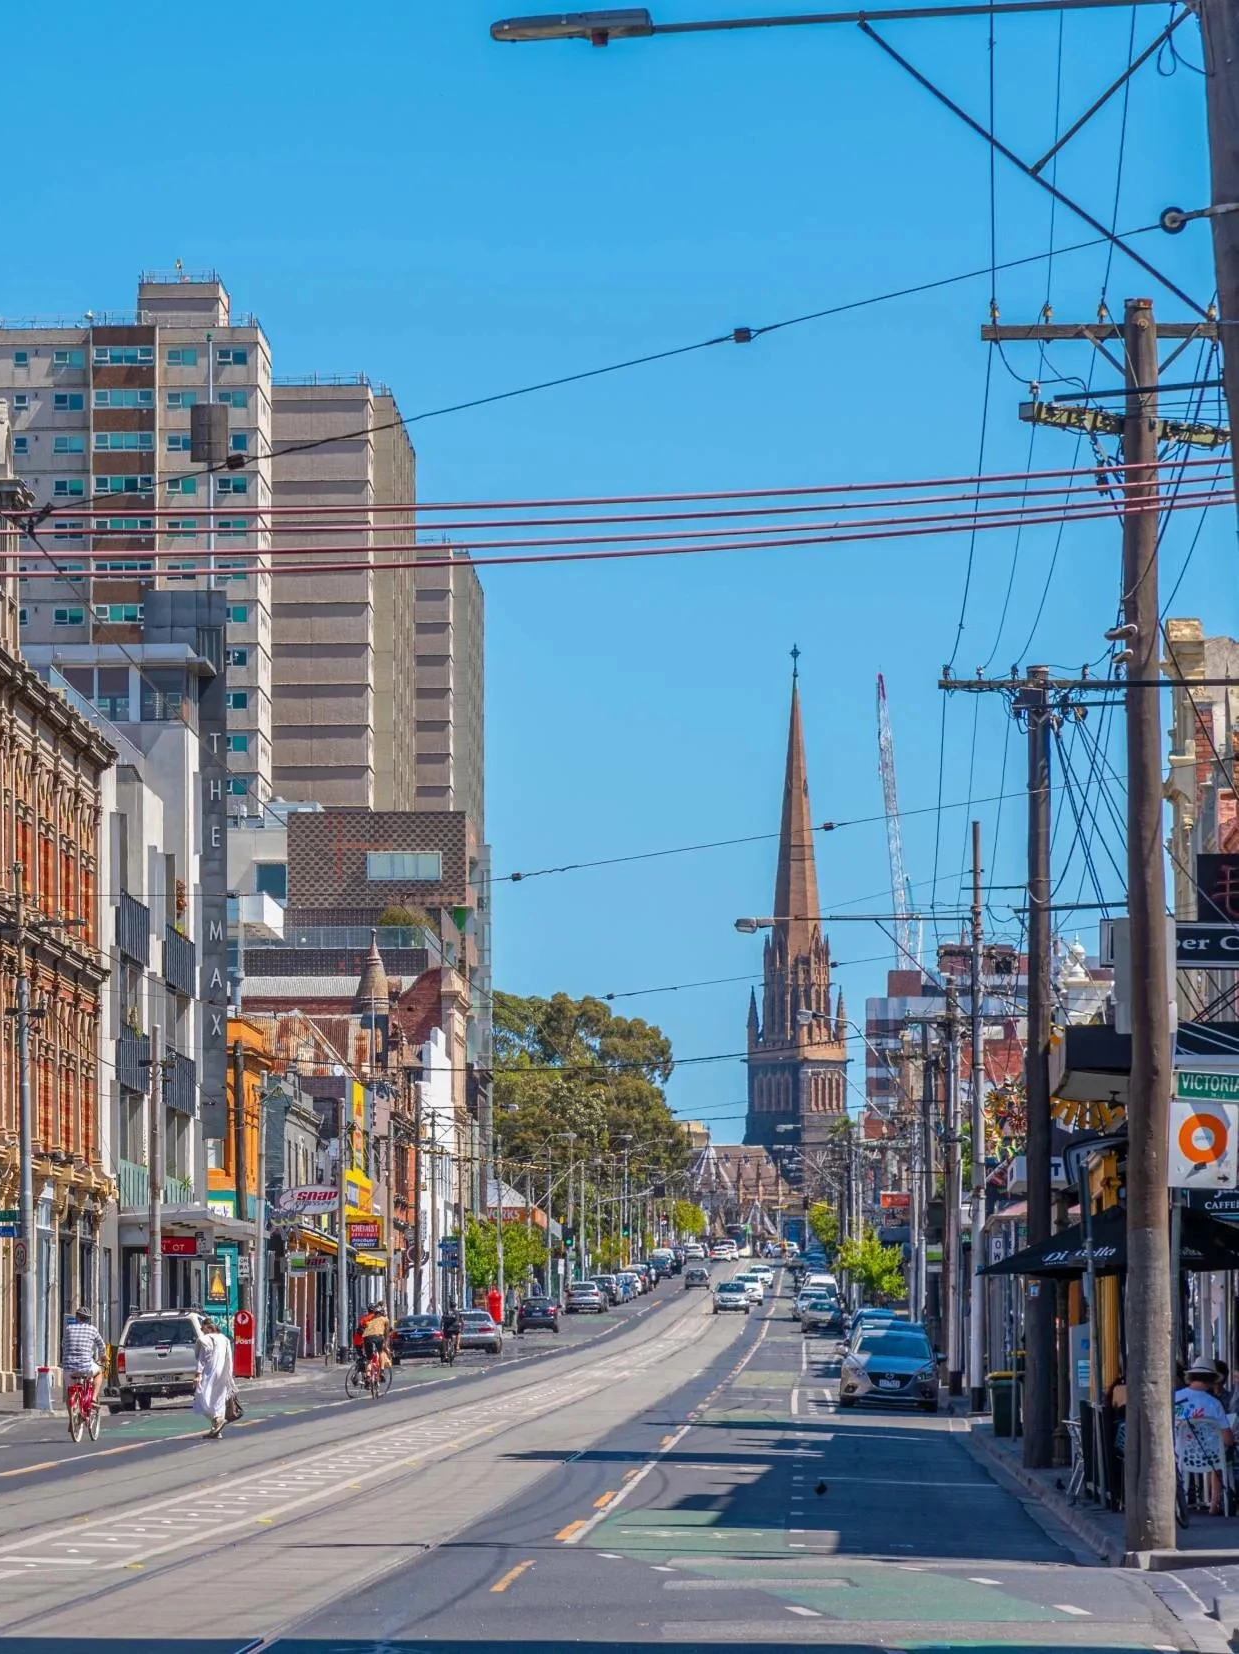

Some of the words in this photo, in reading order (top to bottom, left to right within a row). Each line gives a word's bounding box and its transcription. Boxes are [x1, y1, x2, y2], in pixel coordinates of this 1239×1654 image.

[209, 732, 222, 848] THE
[209, 920, 224, 1036] MAX
[296, 1190, 339, 1201] snap
